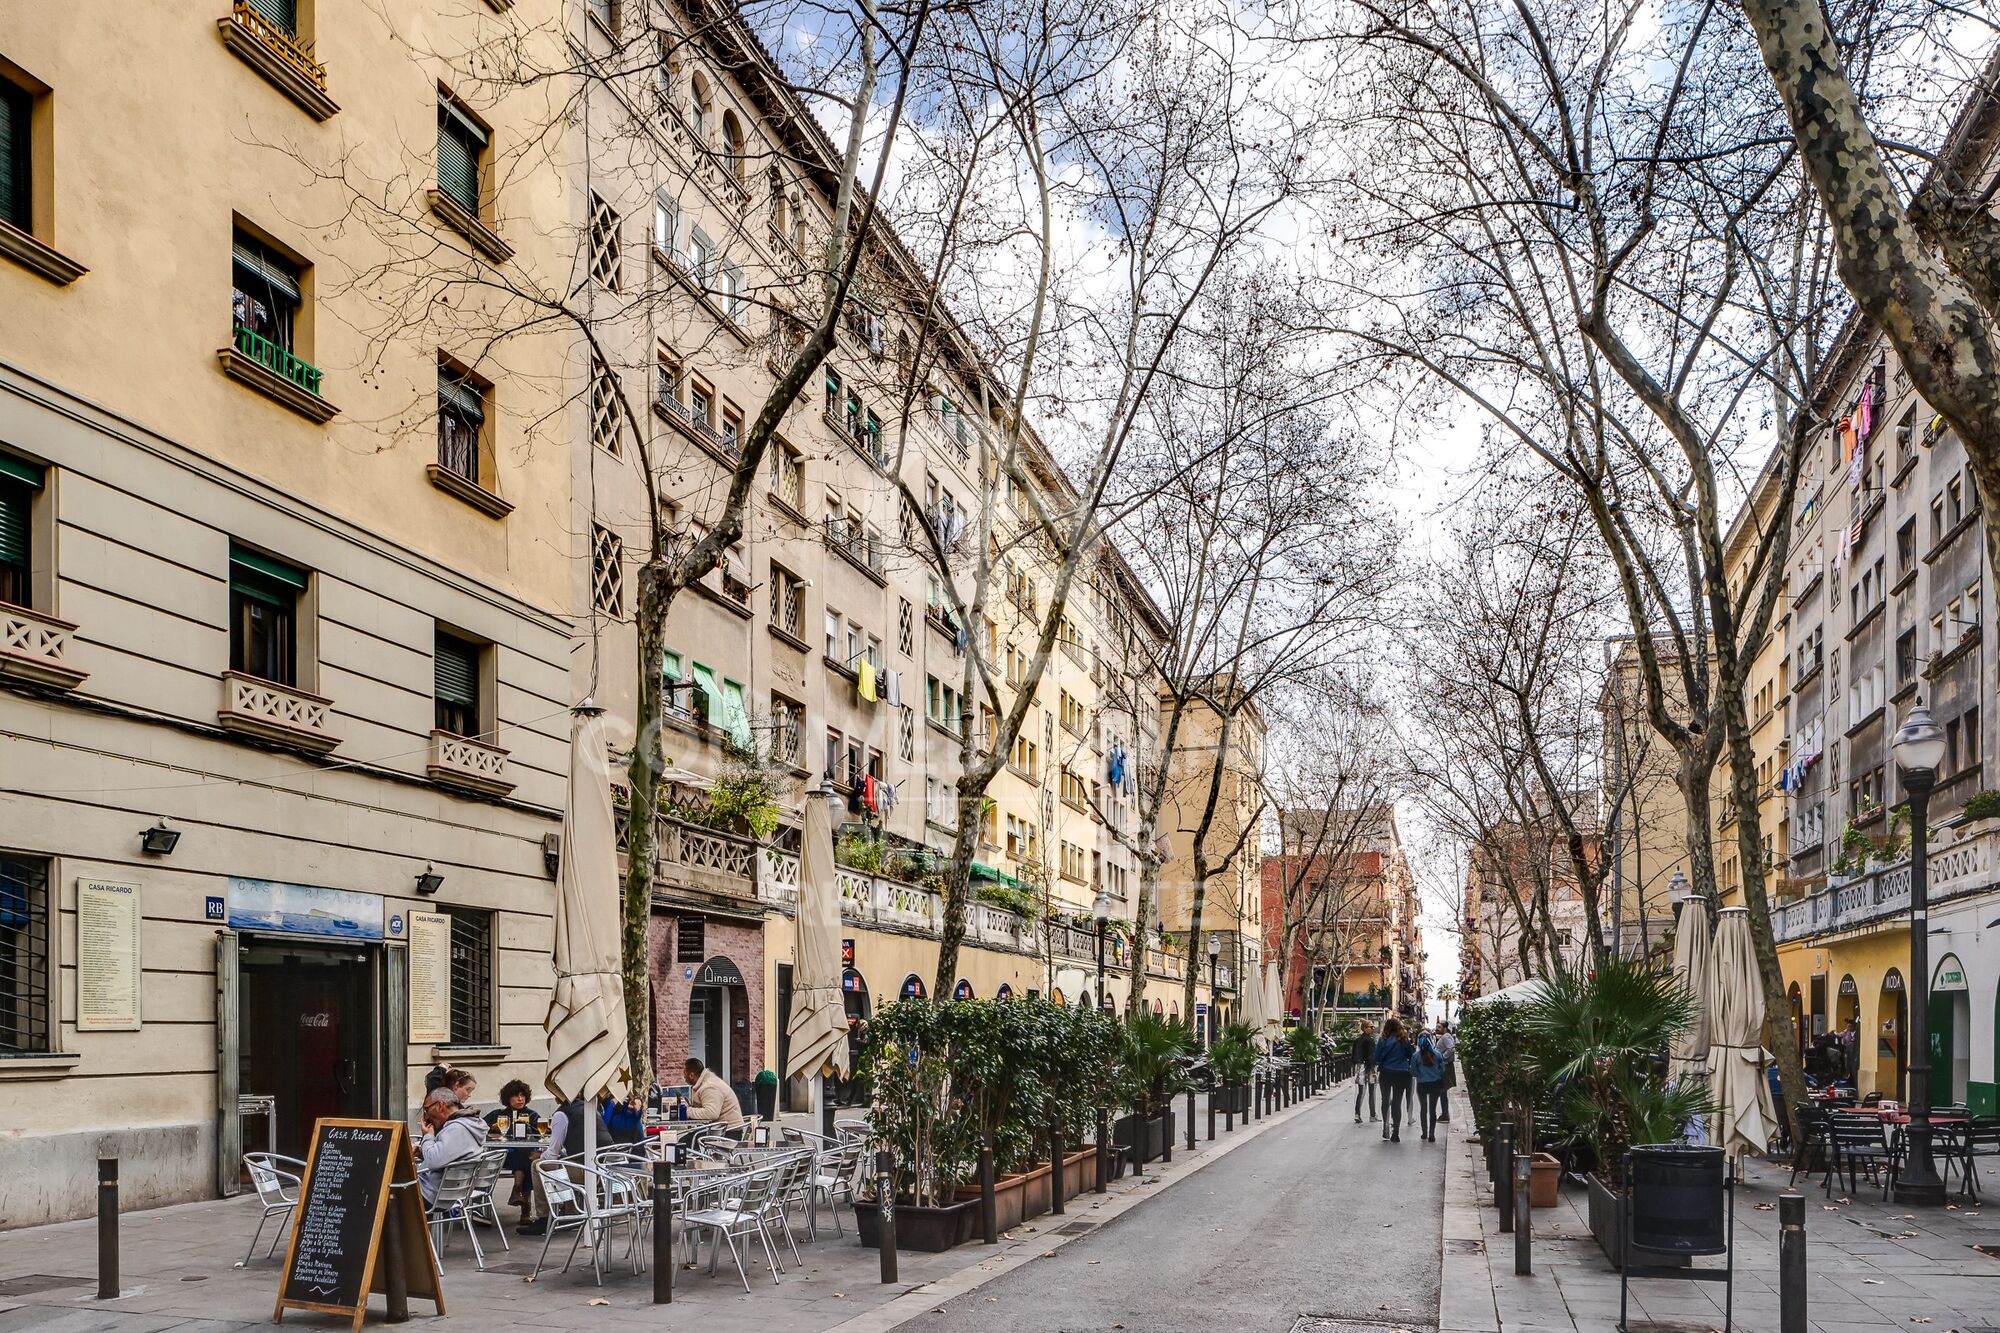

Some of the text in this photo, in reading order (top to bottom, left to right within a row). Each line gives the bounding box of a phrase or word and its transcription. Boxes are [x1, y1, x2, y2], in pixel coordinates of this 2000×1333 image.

[106, 886, 132, 894] RICARDO
[238, 880, 283, 894] CASA
[208, 902, 223, 914] RB
[1886, 976, 1900, 988] MODA
[351, 1129, 383, 1141] Ricardo
